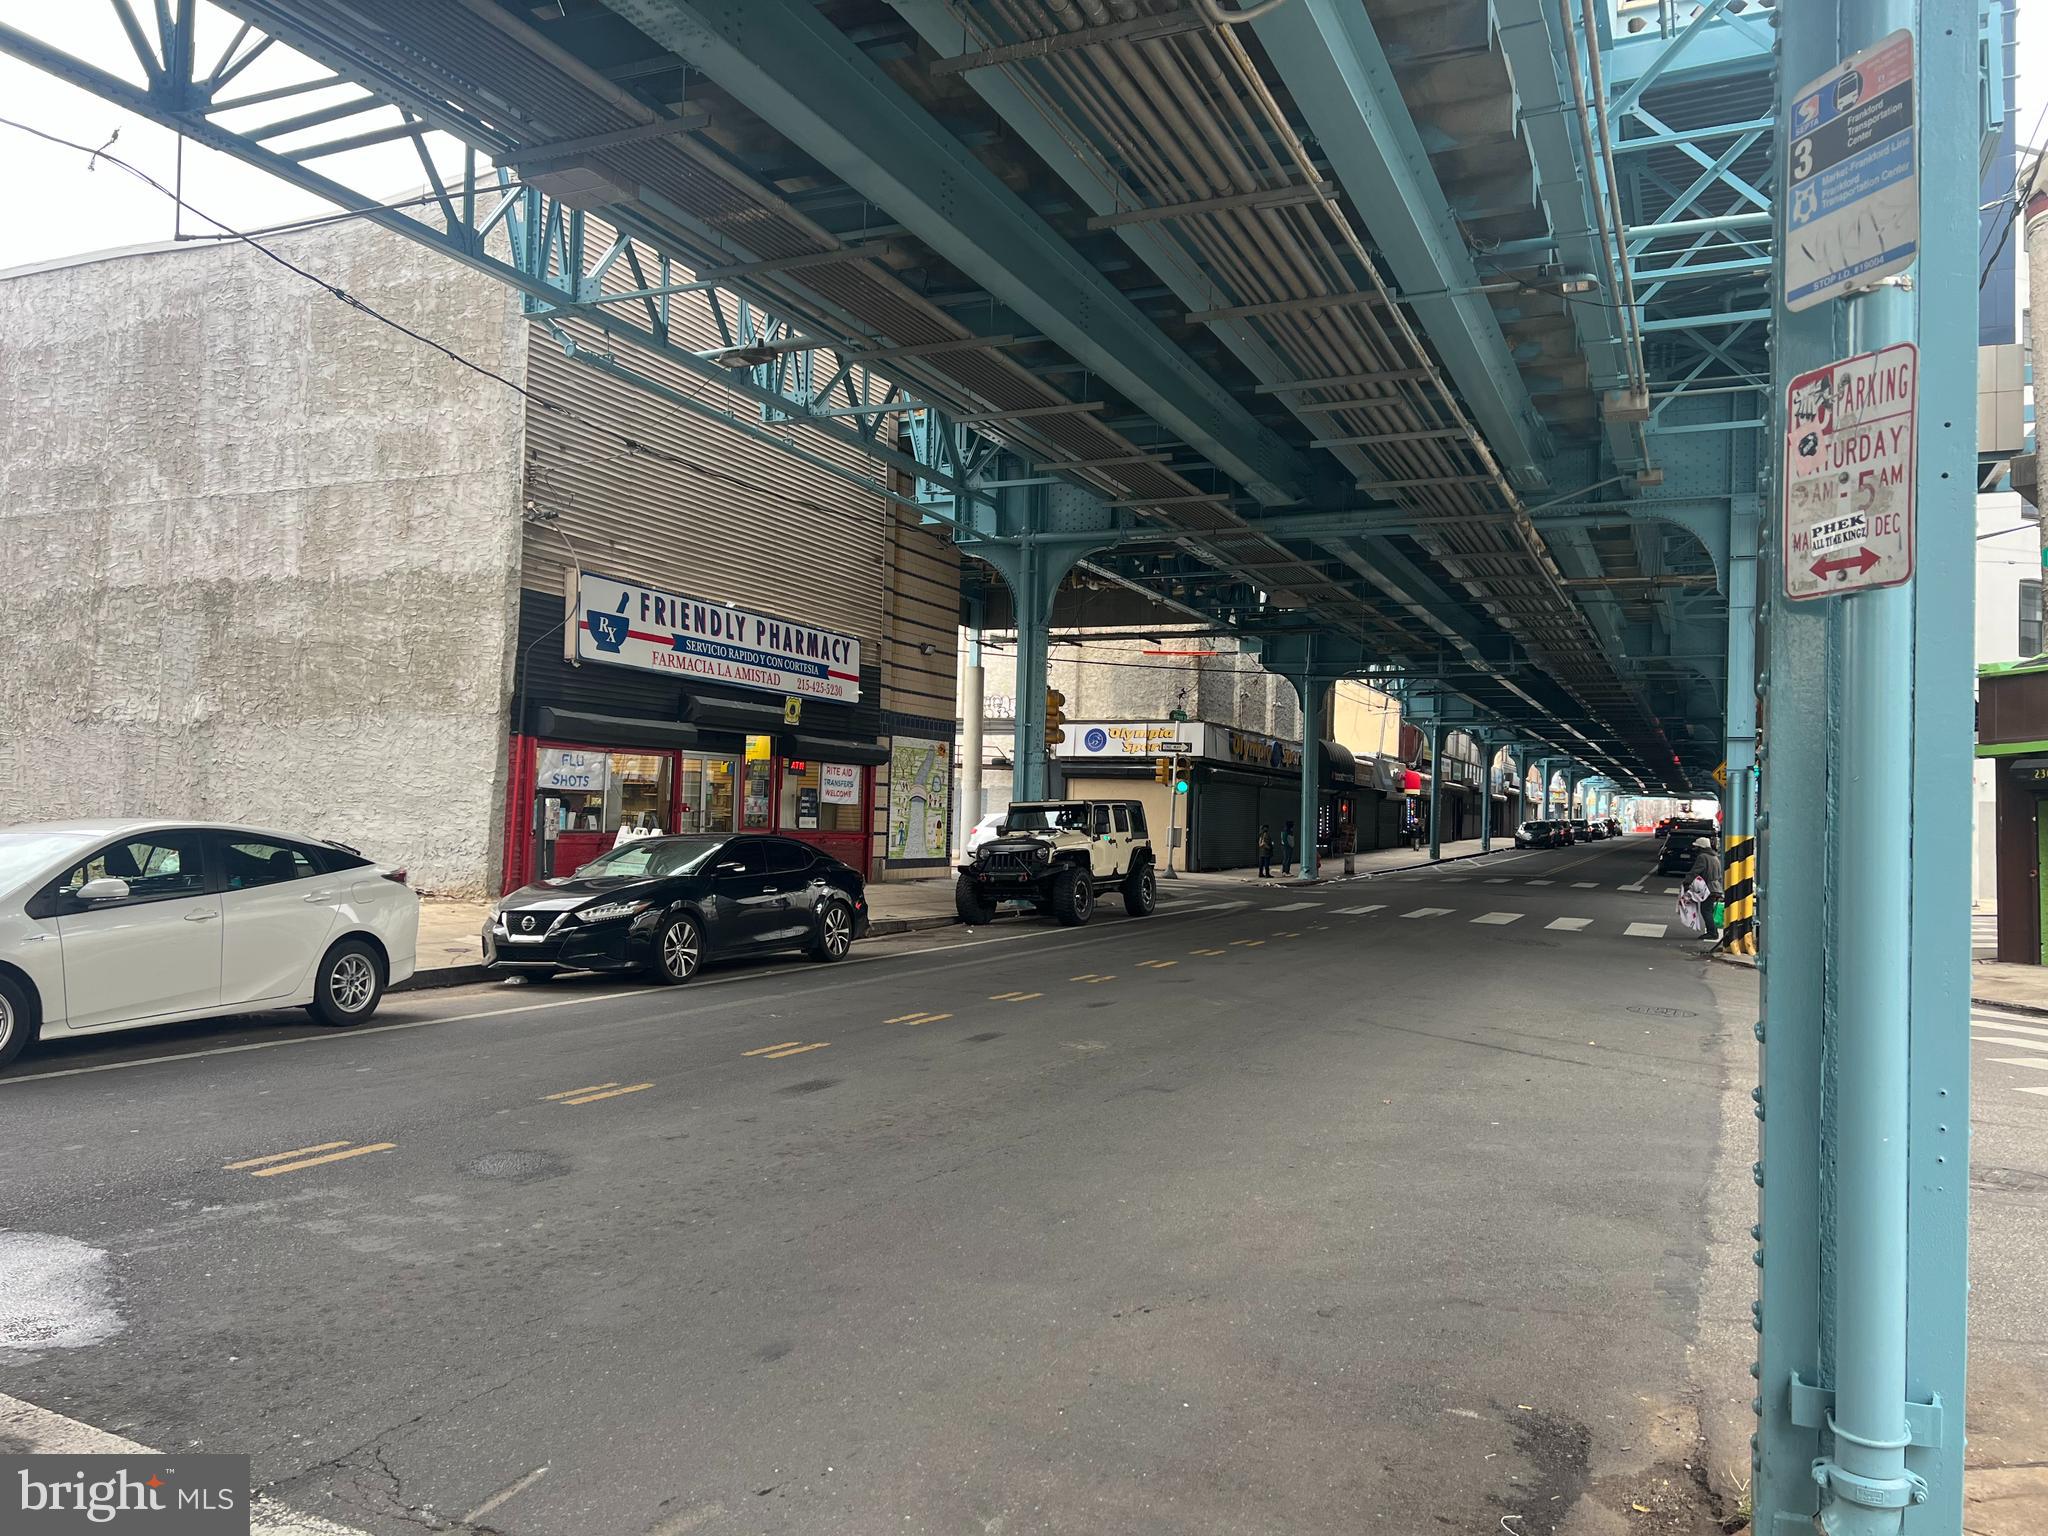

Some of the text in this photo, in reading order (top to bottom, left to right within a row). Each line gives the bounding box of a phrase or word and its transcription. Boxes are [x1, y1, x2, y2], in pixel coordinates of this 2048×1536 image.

[1847, 99, 1884, 126] Frankford
[1847, 102, 1903, 137] Transportation
[1795, 118, 1819, 136] SEPTA
[1847, 128, 1872, 147] Center
[1794, 138, 1813, 179] 3
[1821, 161, 1910, 208] Transportation Center
[1821, 172, 1861, 199] Frankford
[1813, 275, 1837, 291] STOP
[1836, 363, 1908, 416] PARKING
[1858, 469, 1876, 511] 5
[1879, 464, 1903, 486] AM
[1811, 514, 1866, 538] PHEK
[1875, 512, 1901, 537] DEC
[1812, 539, 1825, 551] ALL
[640, 592, 851, 665] FRIENDLY PHARMACY
[685, 639, 819, 676] SERVICIO RAPIDO Y CON CORTESIA
[652, 650, 843, 697] FARMACIA LA AMISTAD 215-425-5230
[1108, 727, 1175, 741] Olympia
[561, 753, 585, 767] FLU
[790, 761, 804, 770] ATM
[551, 773, 590, 787] SHOTS
[826, 766, 853, 777] RITE AID
[2034, 768, 2048, 779] 23
[824, 778, 854, 788] TRANSFERS
[825, 789, 852, 798] WELCOME
